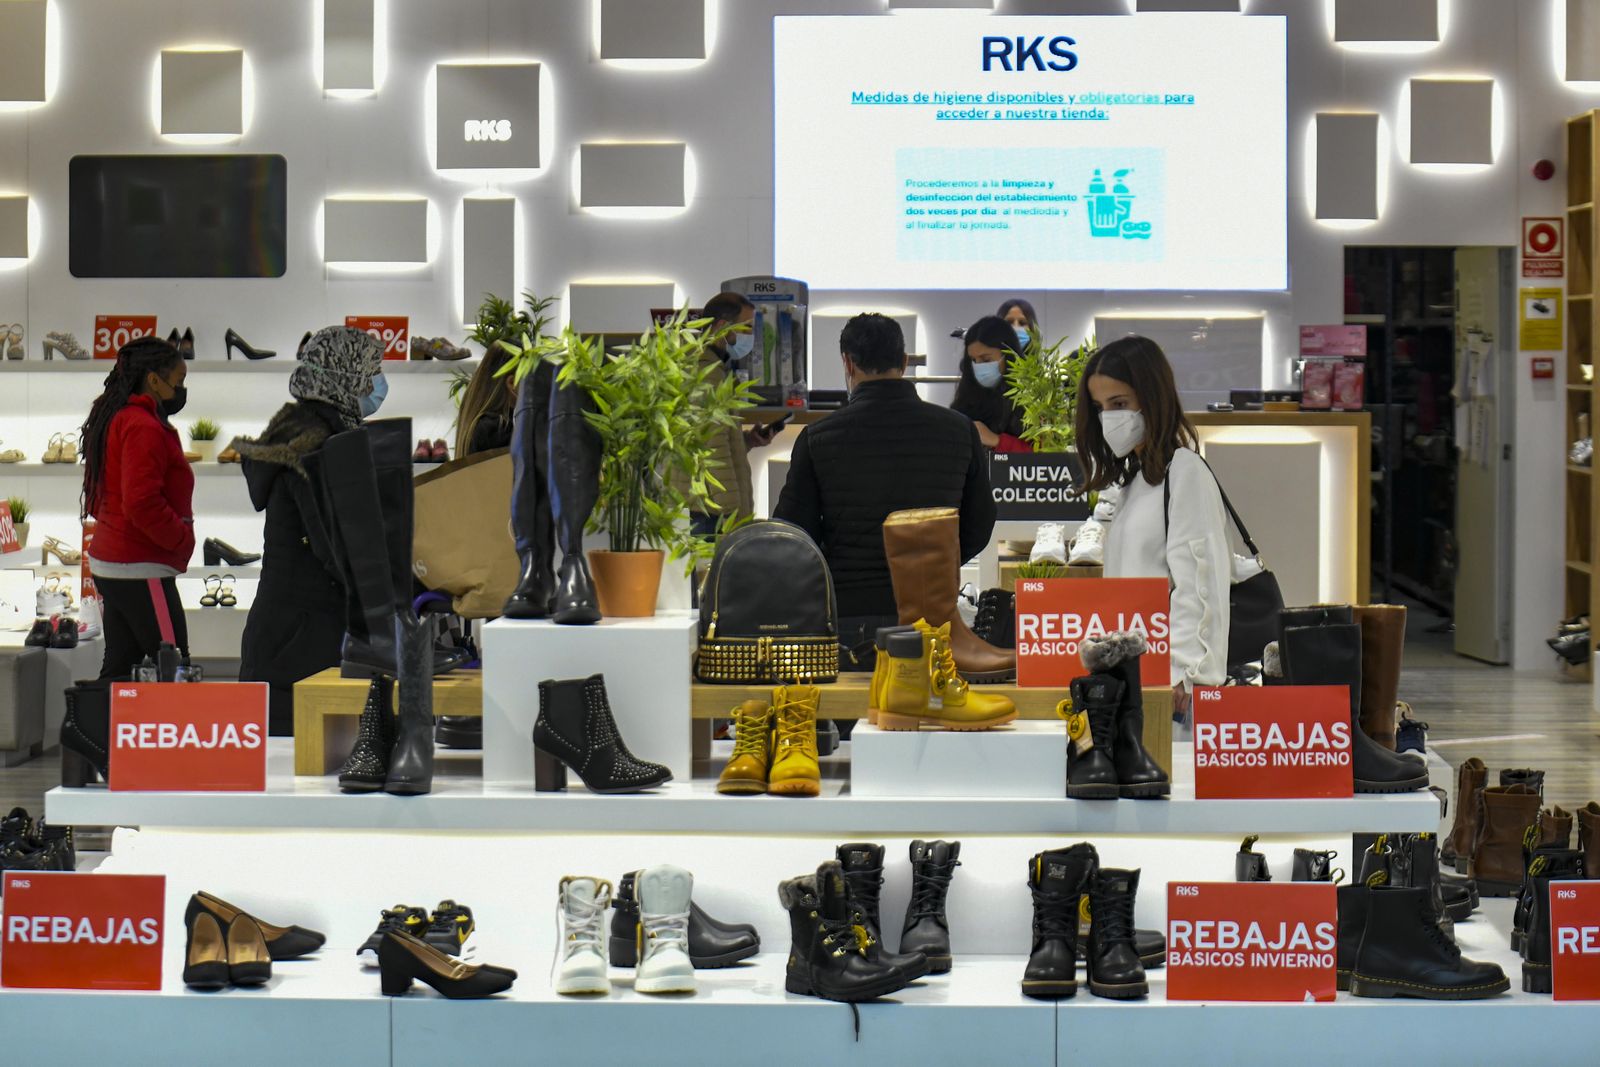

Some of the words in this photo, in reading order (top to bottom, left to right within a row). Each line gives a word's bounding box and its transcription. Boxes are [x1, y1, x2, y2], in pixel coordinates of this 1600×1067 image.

[982, 36, 1079, 72] RKS
[852, 91, 909, 103] Medidas
[913, 91, 930, 103] de
[934, 91, 983, 106] higiene
[987, 91, 1064, 105] disponibles
[1068, 94, 1077, 105] y
[1079, 92, 1160, 106] obligatorias
[1164, 94, 1195, 105] para
[936, 107, 989, 119] acceder
[994, 110, 1001, 119] a
[1006, 109, 1057, 119] nuestra
[1062, 107, 1109, 119] tienda:
[464, 119, 512, 142] RKS
[905, 179, 979, 188] Procederemos
[991, 179, 999, 188] la
[1002, 179, 1046, 189] limpieza
[1048, 181, 1055, 190] y
[976, 193, 991, 201] del
[994, 192, 1078, 201] establecimiento
[905, 207, 925, 216] dos
[928, 208, 958, 216] veces
[961, 208, 978, 218] por
[1002, 208, 1011, 216] al
[1063, 209, 1070, 218] y
[905, 221, 914, 230] al
[917, 221, 956, 230] finalizar
[959, 221, 968, 230] la
[753, 282, 777, 293] RKS
[1008, 466, 1073, 482] NUEVA
[991, 484, 1088, 503] COLECCIÓN
[1022, 582, 1045, 592] RKS
[1018, 612, 1170, 640] REBAJAS
[1018, 638, 1079, 656] BÁSICO
[119, 688, 138, 698] RKS
[1199, 690, 1223, 701] RKS
[116, 722, 262, 749] REBAJAS
[1195, 721, 1351, 751] REBAJAS
[1196, 749, 1268, 767] BÁSICOS
[1272, 751, 1351, 767] INVIERNO
[11, 879, 32, 889] RKS
[1175, 885, 1200, 897] RKS
[1557, 889, 1577, 900] RKS
[7, 915, 160, 945] REBAJAS
[1169, 919, 1337, 951] REBAJAS
[1168, 948, 1245, 967] BÁSICOS
[1251, 953, 1335, 969] INVIERNO
